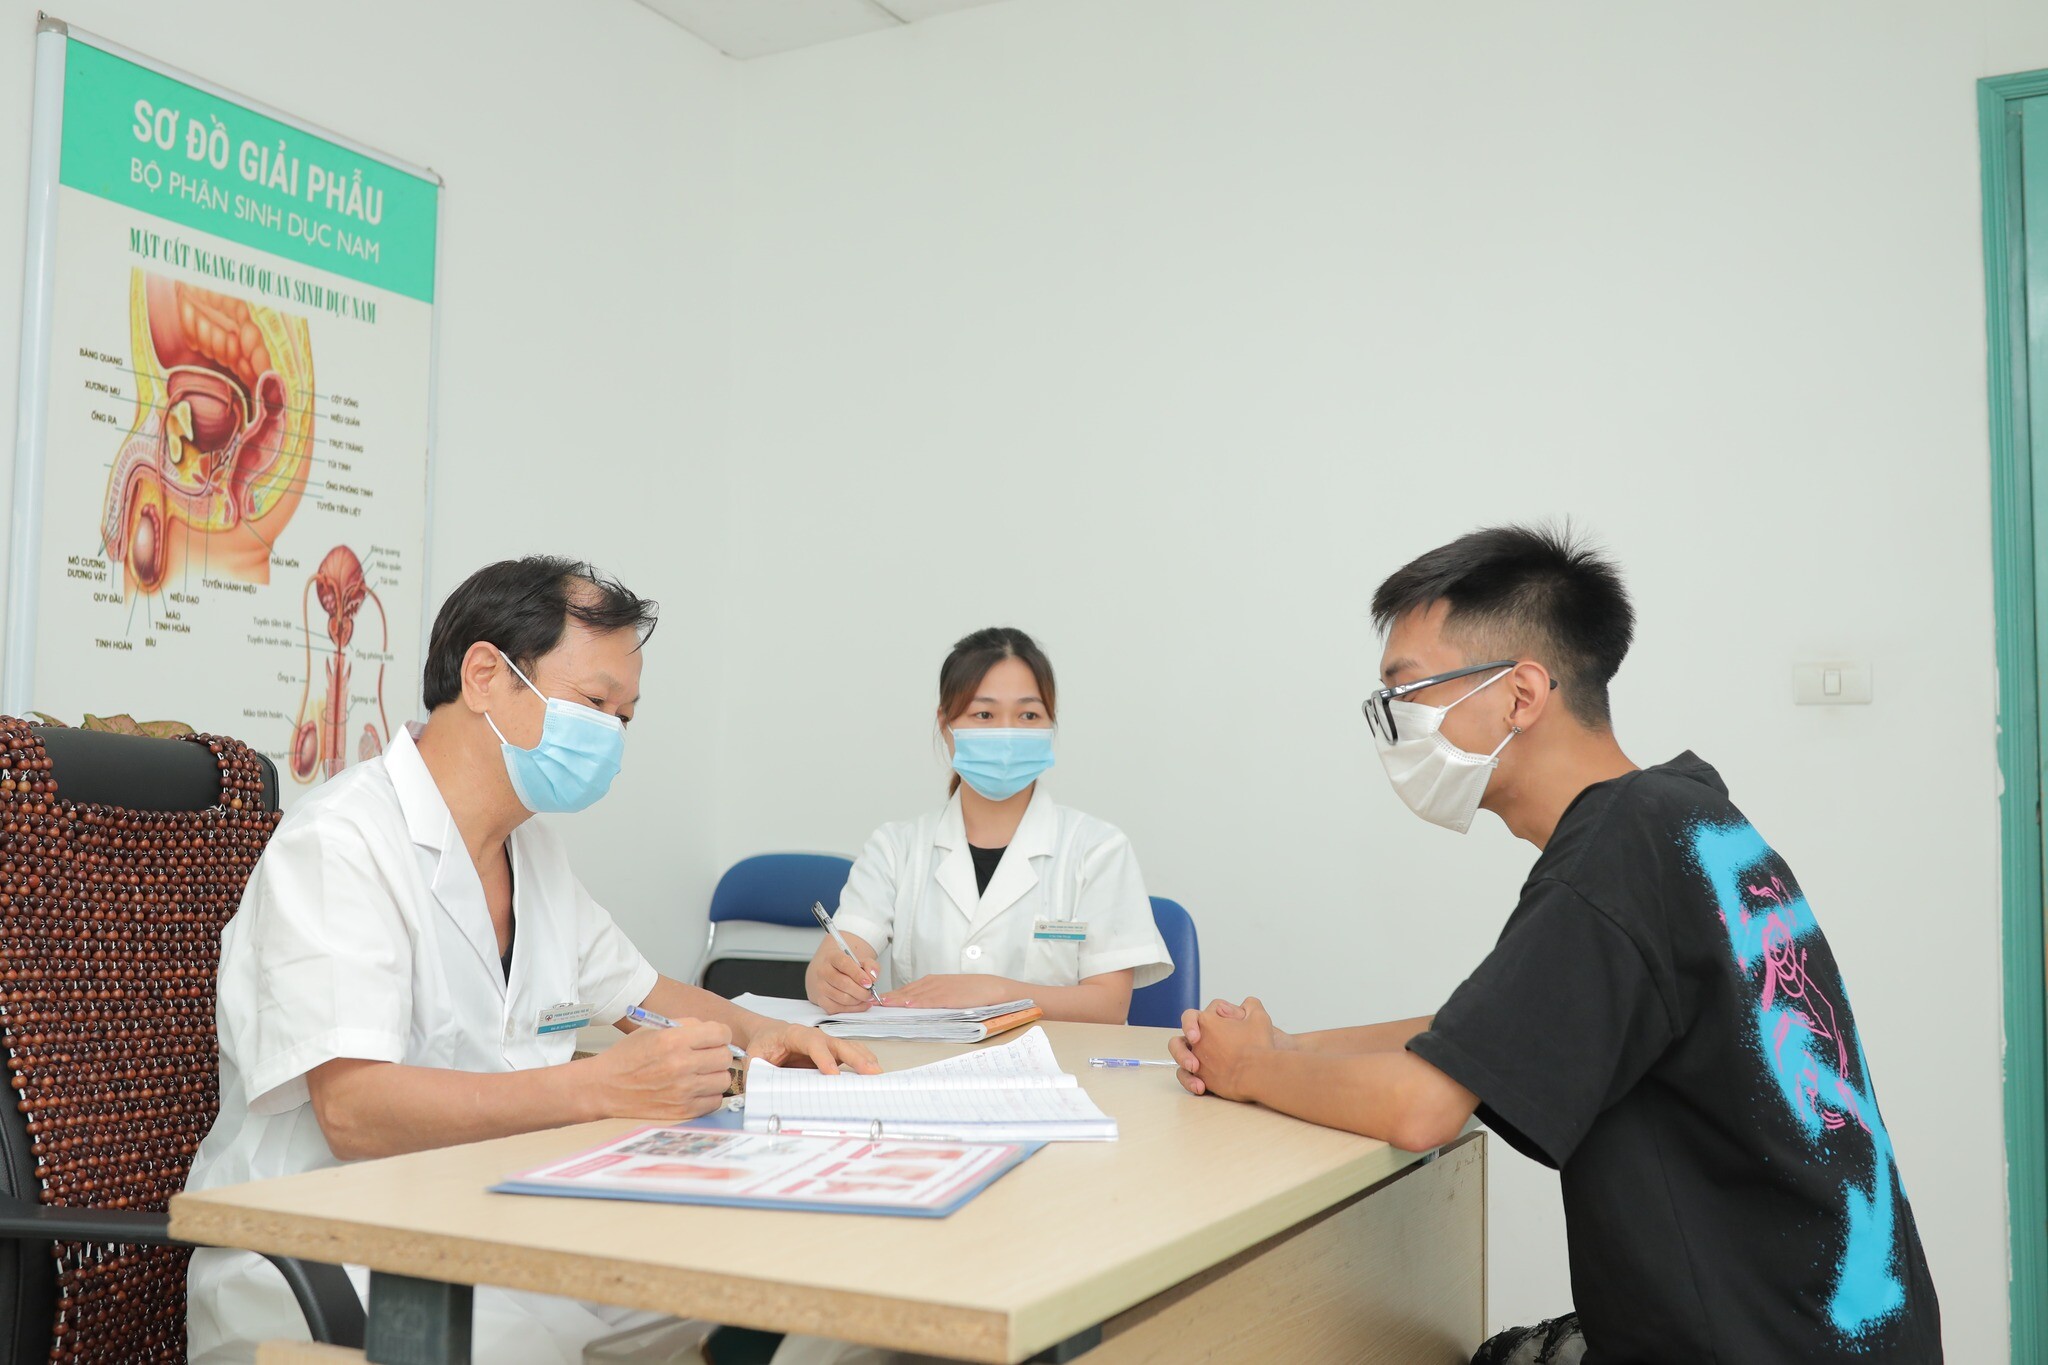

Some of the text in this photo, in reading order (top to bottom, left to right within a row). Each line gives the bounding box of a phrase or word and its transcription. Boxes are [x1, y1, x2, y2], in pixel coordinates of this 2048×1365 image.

[133, 99, 383, 226] SƠ ĐỒ GIẢI PHẪU
[130, 157, 380, 264] BỘ PHẬN SINH DỤC NAM
[194, 247, 235, 282] NGANG
[258, 267, 291, 299] QUAN
[293, 279, 322, 309] SINH
[326, 289, 349, 318] DỤC
[352, 296, 376, 325] NAM
[99, 353, 123, 366] QUANG
[107, 414, 118, 425] RA
[67, 555, 80, 565] MÔ
[93, 592, 108, 603] QUY
